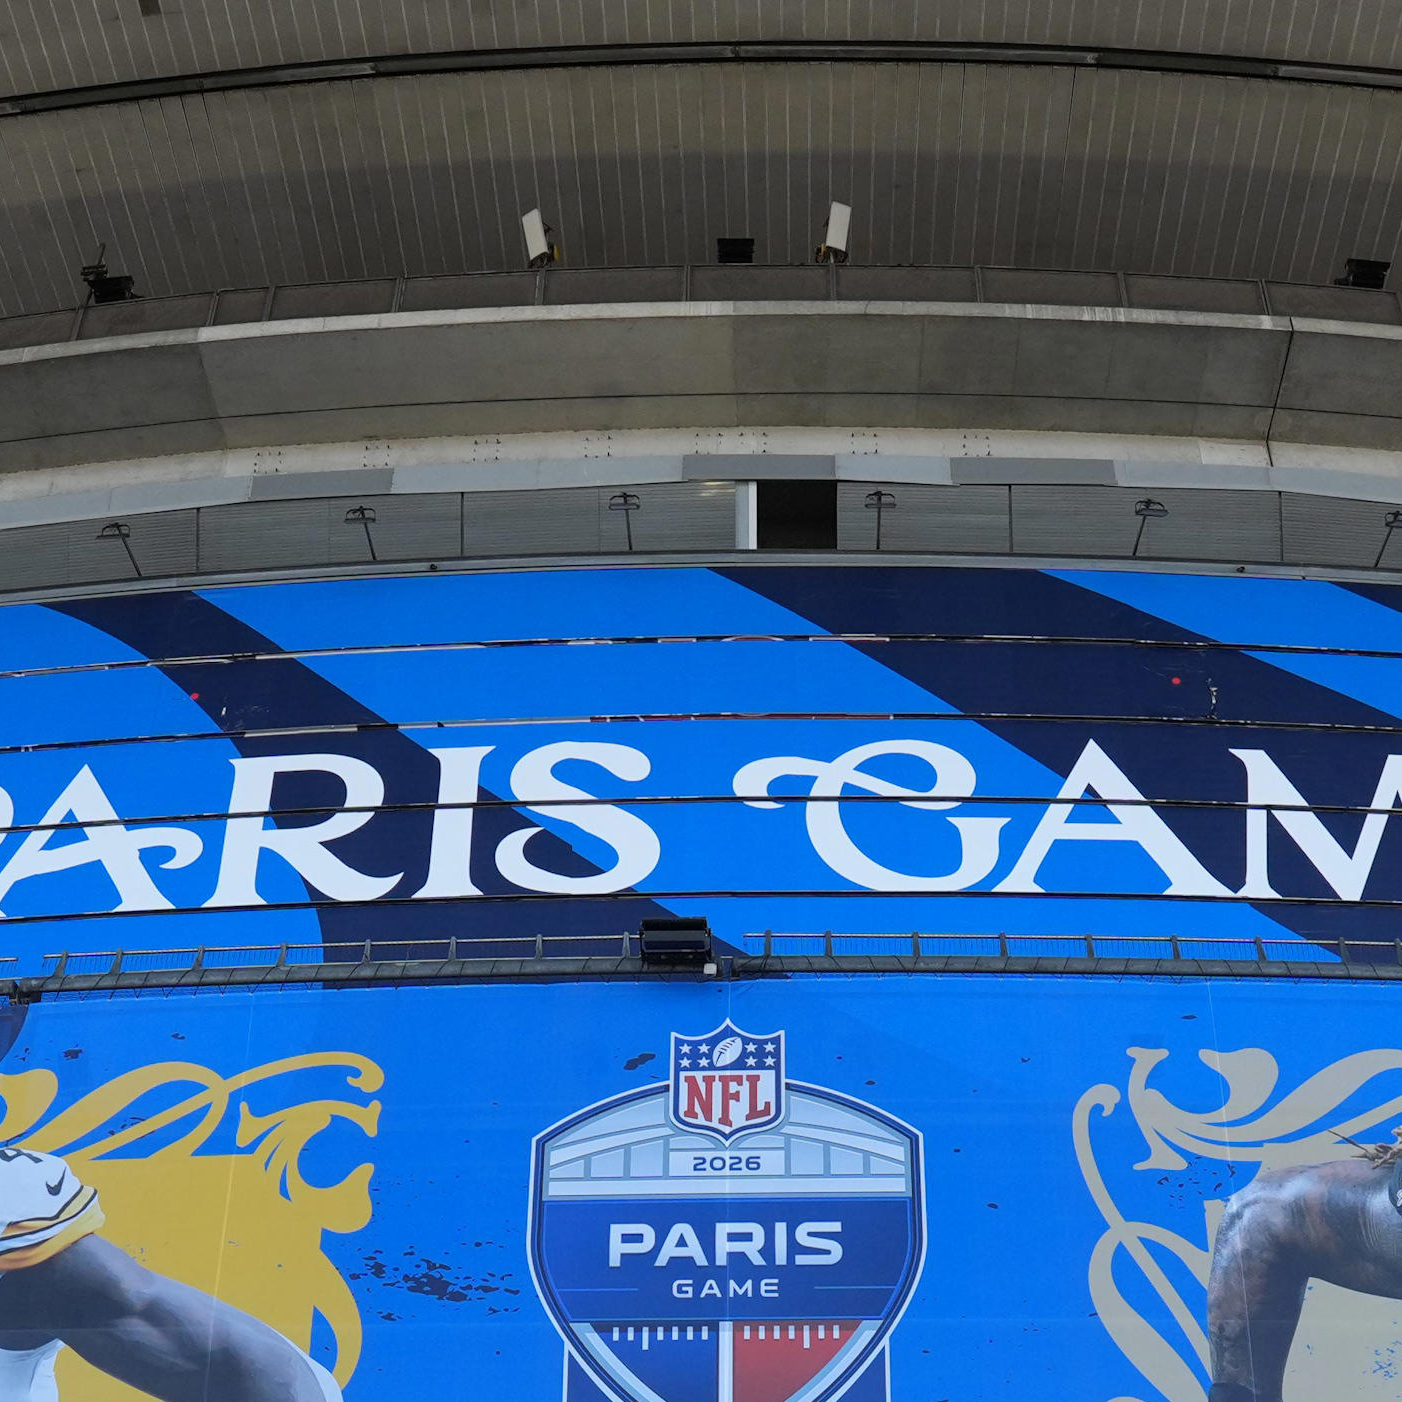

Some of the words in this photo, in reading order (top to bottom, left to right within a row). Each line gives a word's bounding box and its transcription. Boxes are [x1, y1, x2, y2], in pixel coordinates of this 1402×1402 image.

[683, 1074, 771, 1127] NFL
[693, 1156, 761, 1172] 2026
[608, 1221, 844, 1267] PARIS
[672, 1279, 780, 1299] GAME
